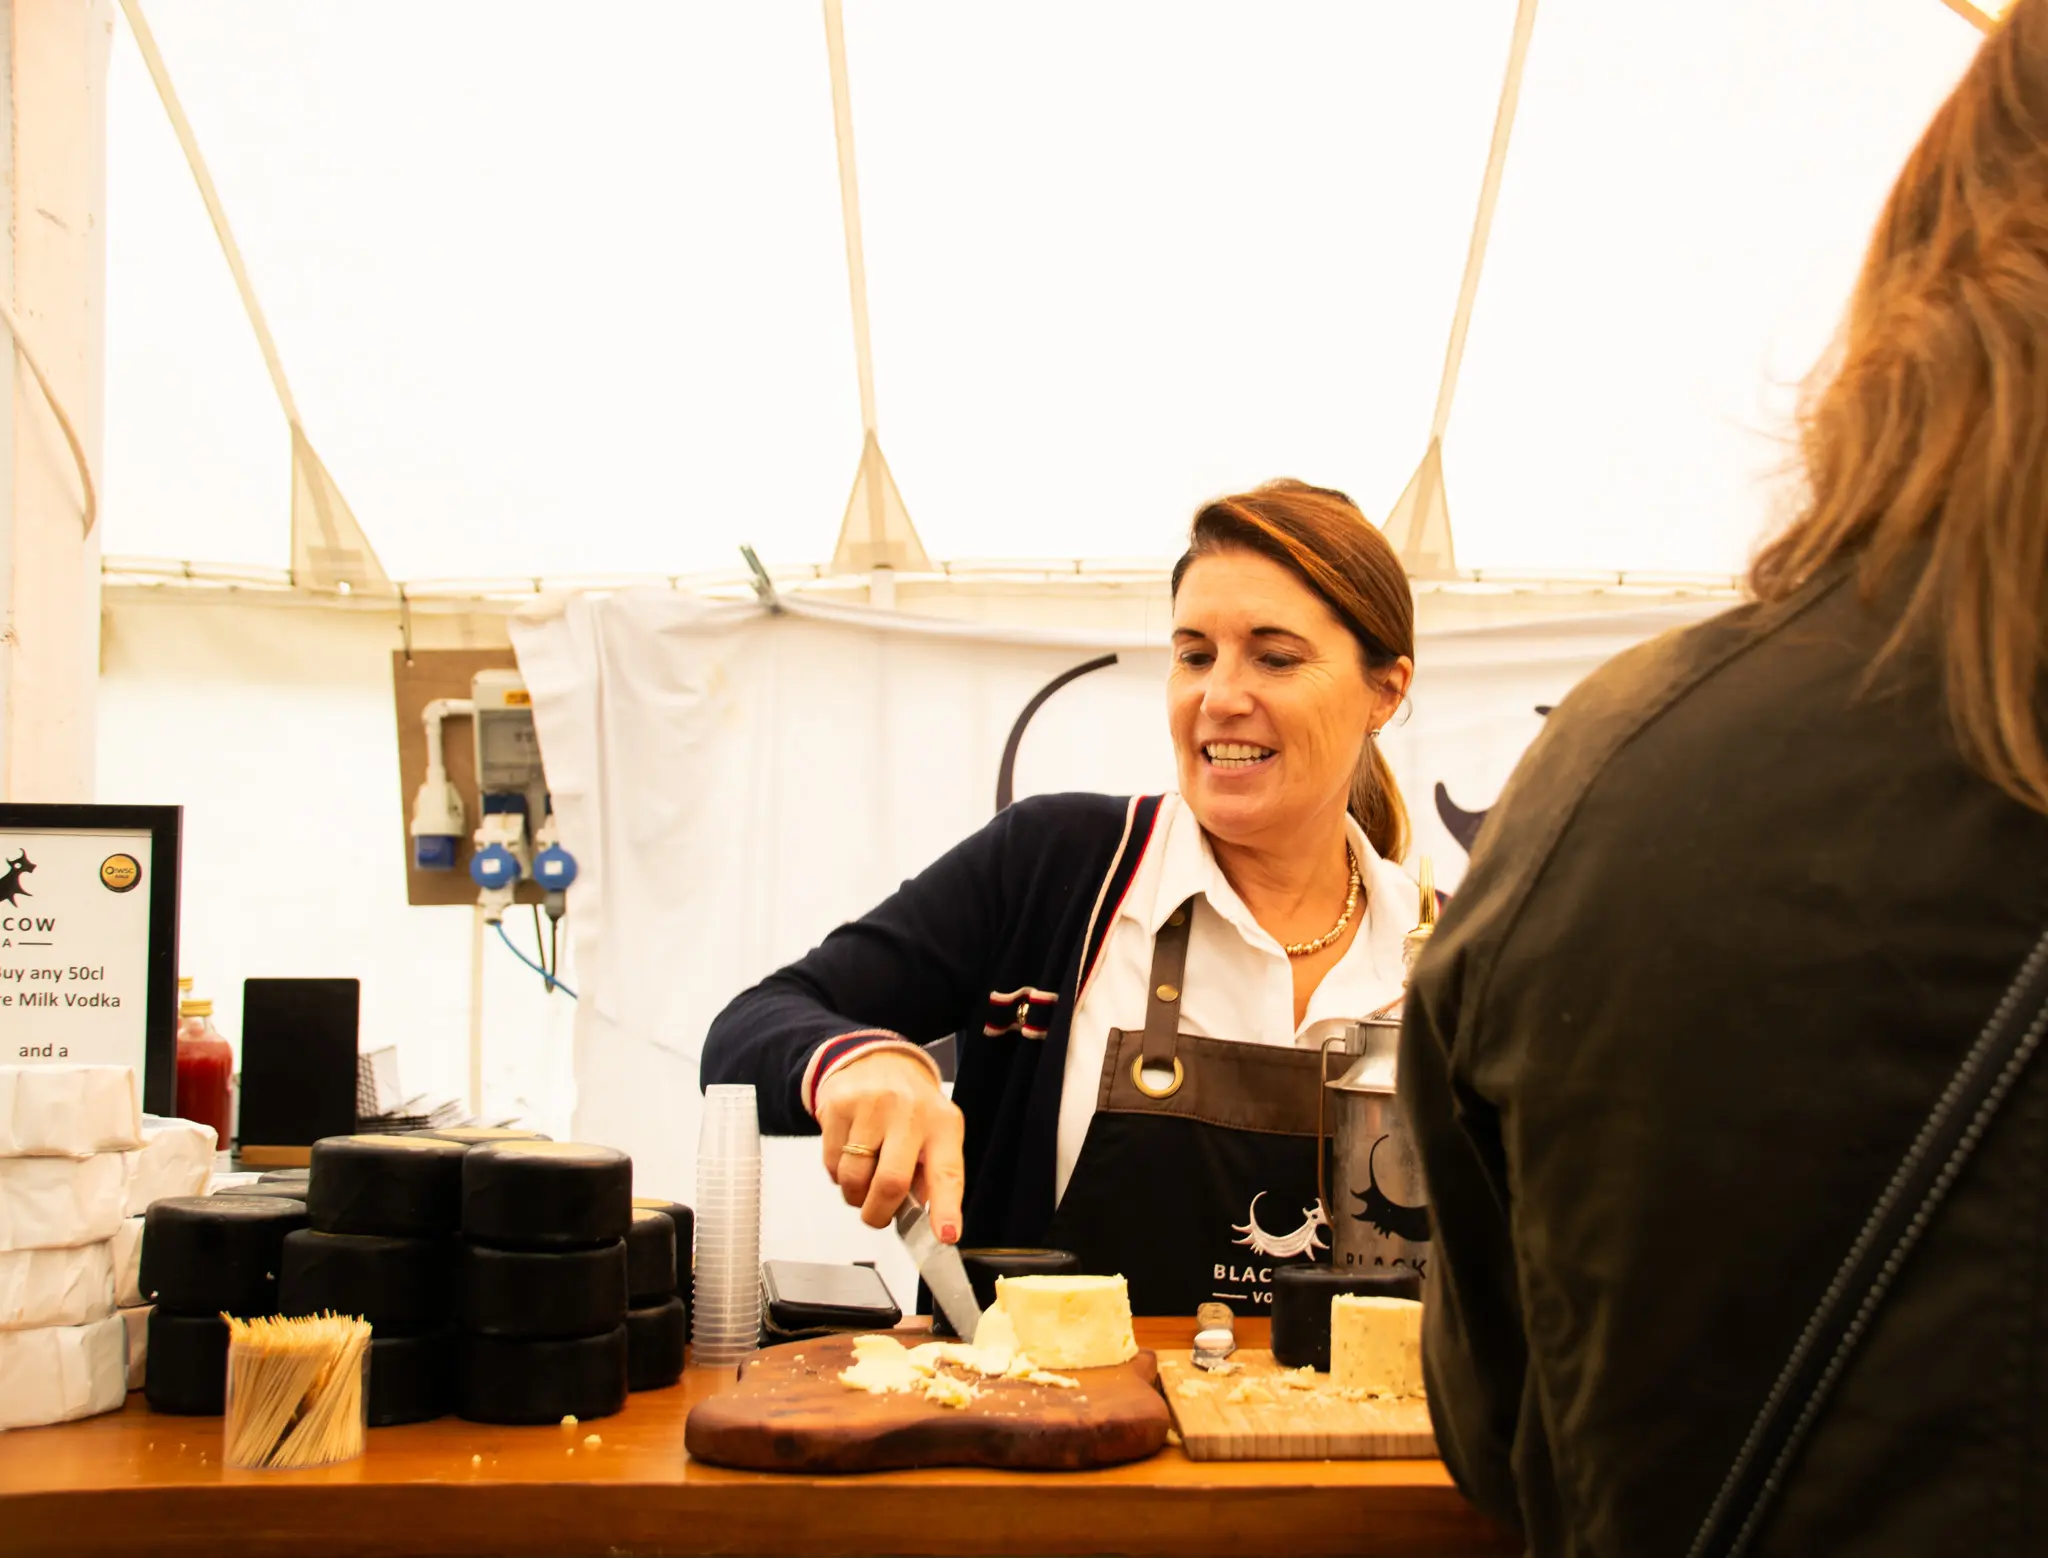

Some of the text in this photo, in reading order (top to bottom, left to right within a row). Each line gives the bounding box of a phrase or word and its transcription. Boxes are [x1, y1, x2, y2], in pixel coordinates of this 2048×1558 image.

[2, 917, 56, 932] COW
[0, 966, 104, 983] uy any 50cl
[0, 992, 121, 1008] e Milk Vodka
[19, 1043, 69, 1058] and a
